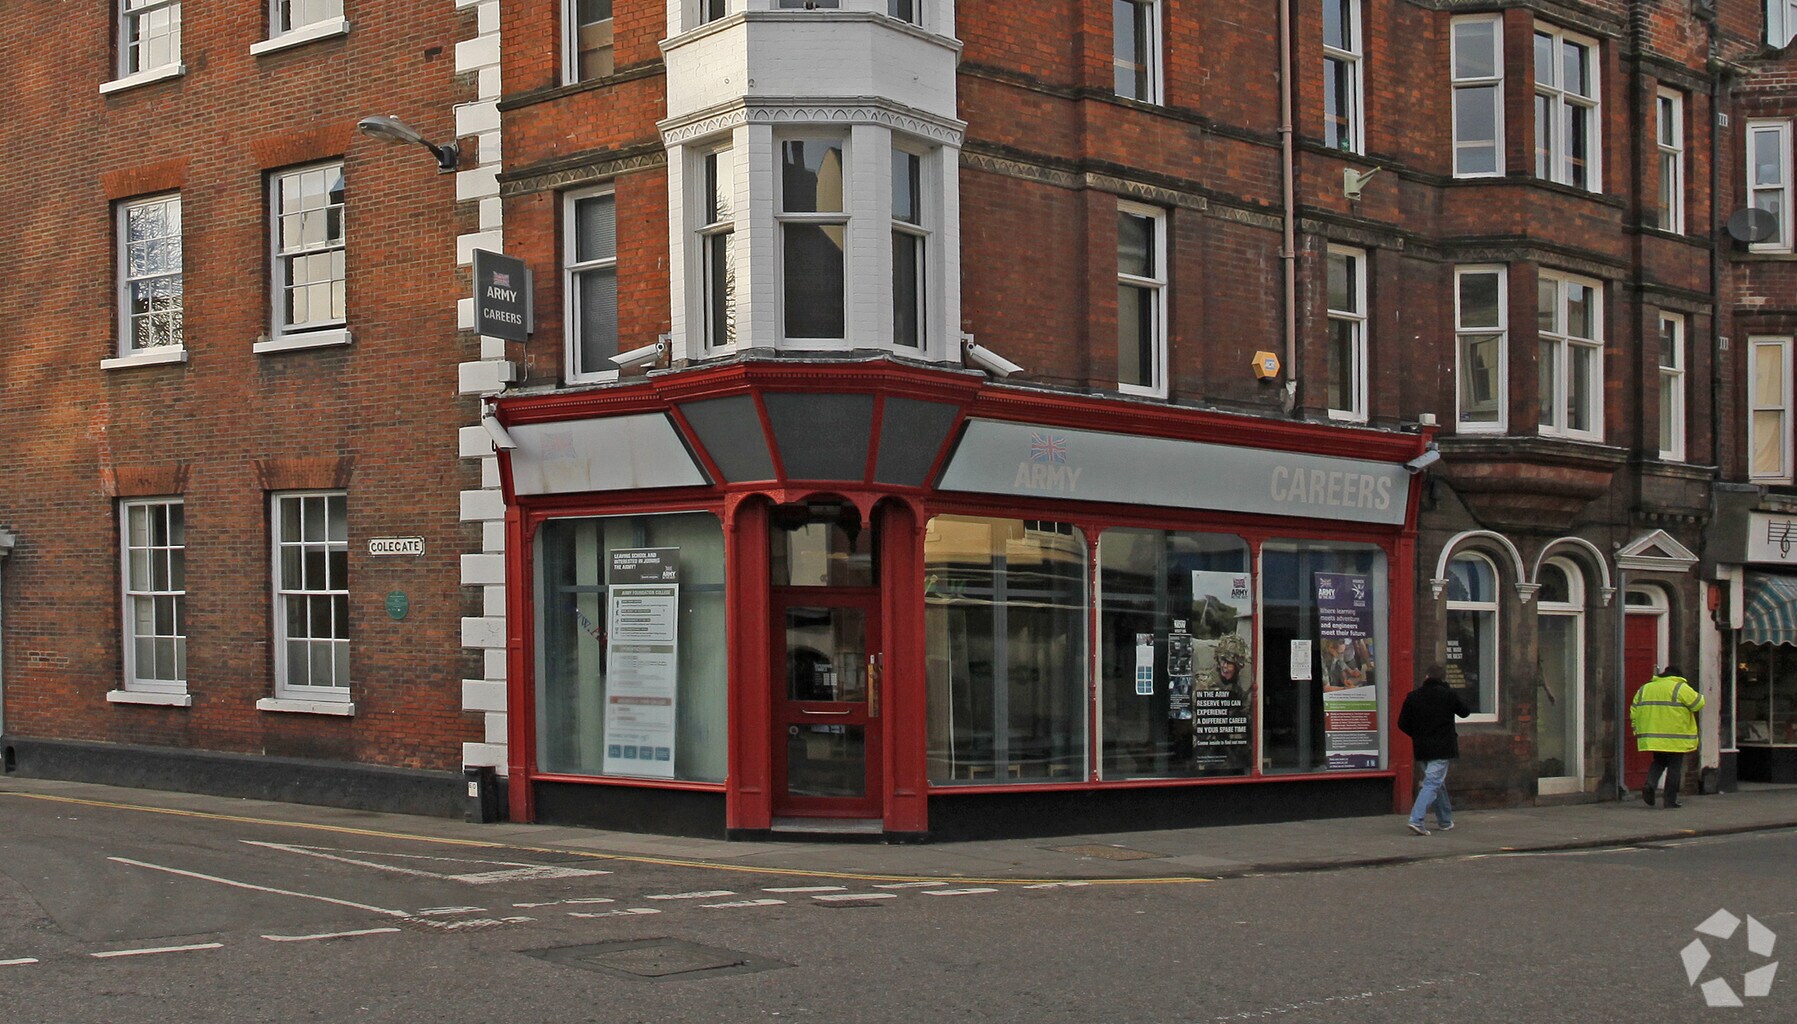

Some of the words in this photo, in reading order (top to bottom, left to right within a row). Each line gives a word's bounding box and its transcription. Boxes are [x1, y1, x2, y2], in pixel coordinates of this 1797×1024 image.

[487, 286, 518, 303] ARMY
[484, 308, 522, 325] CAREERS
[1014, 462, 1082, 493] ARMY
[1271, 465, 1392, 511] CAREERS
[1231, 588, 1248, 596] ARMY
[1318, 588, 1335, 596] ARMY
[1336, 608, 1356, 616] learning
